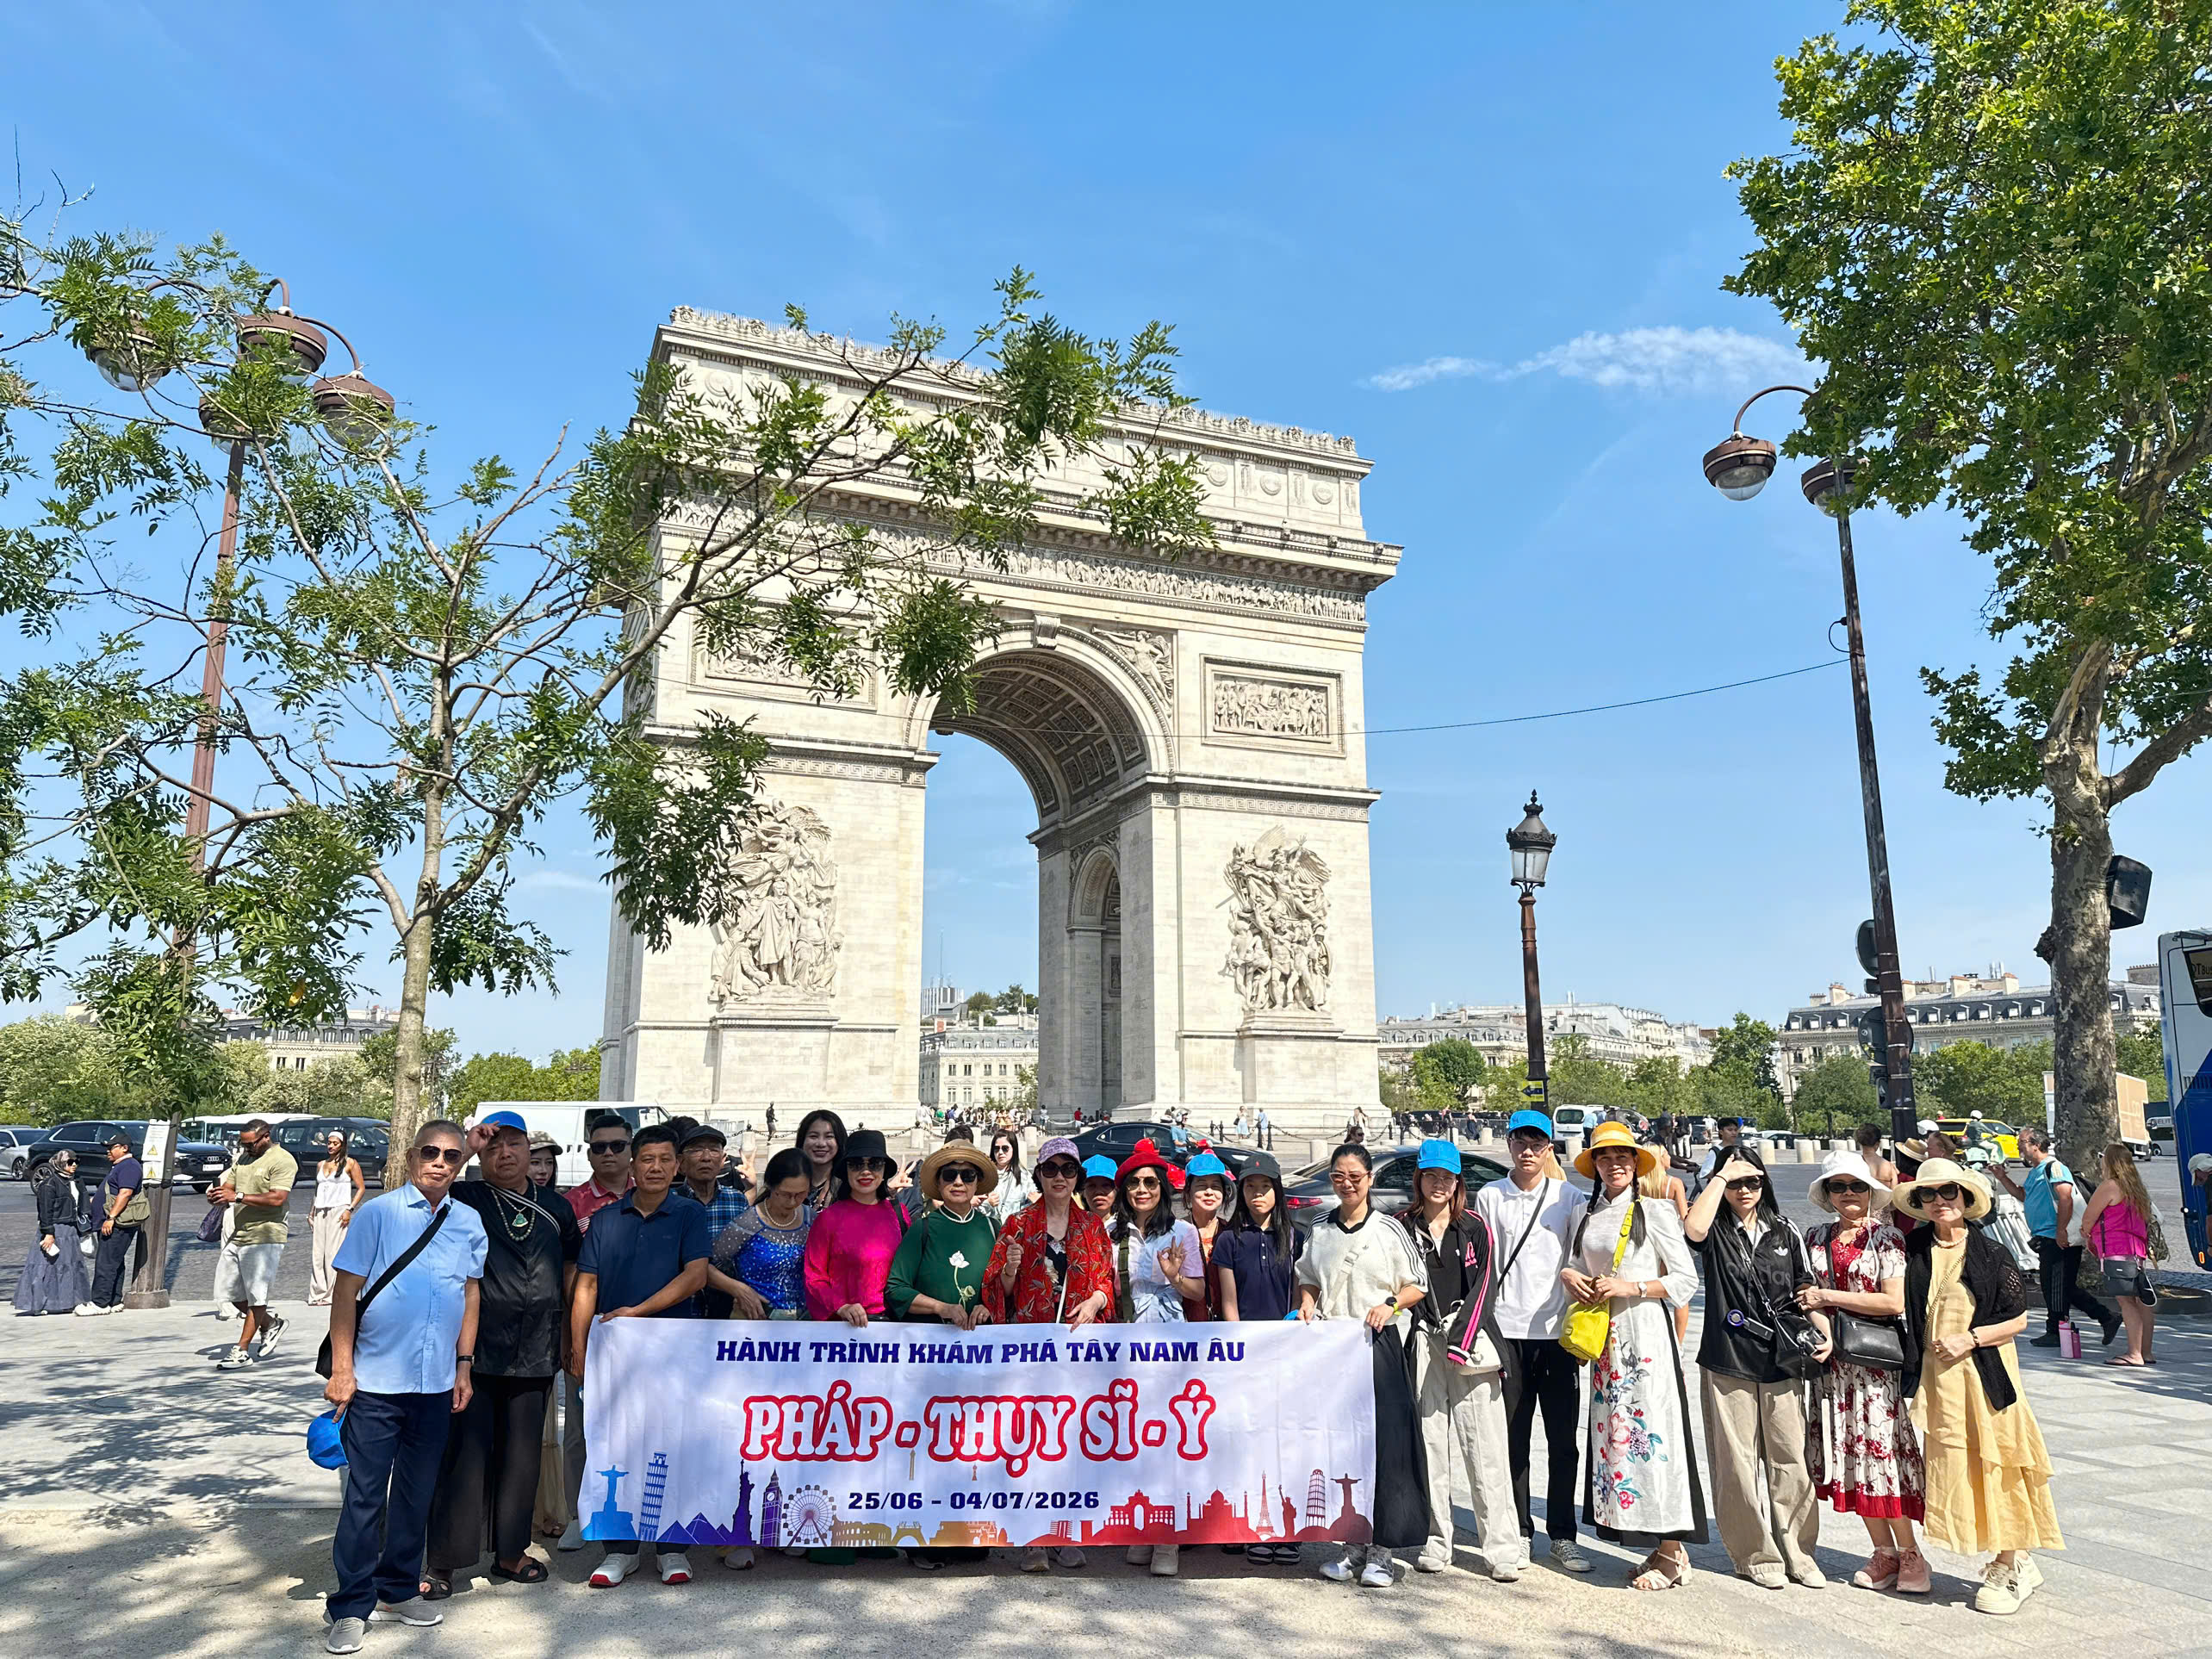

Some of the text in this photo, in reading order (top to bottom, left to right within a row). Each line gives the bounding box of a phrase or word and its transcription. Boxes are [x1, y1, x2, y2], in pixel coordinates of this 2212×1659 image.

[716, 1337, 1246, 1364] HÀNH TRÌNH KHÁM PHÁ TÂY NAM ÂU
[848, 1492, 923, 1510] 25/06
[949, 1491, 1100, 1510] 04/07/2026
